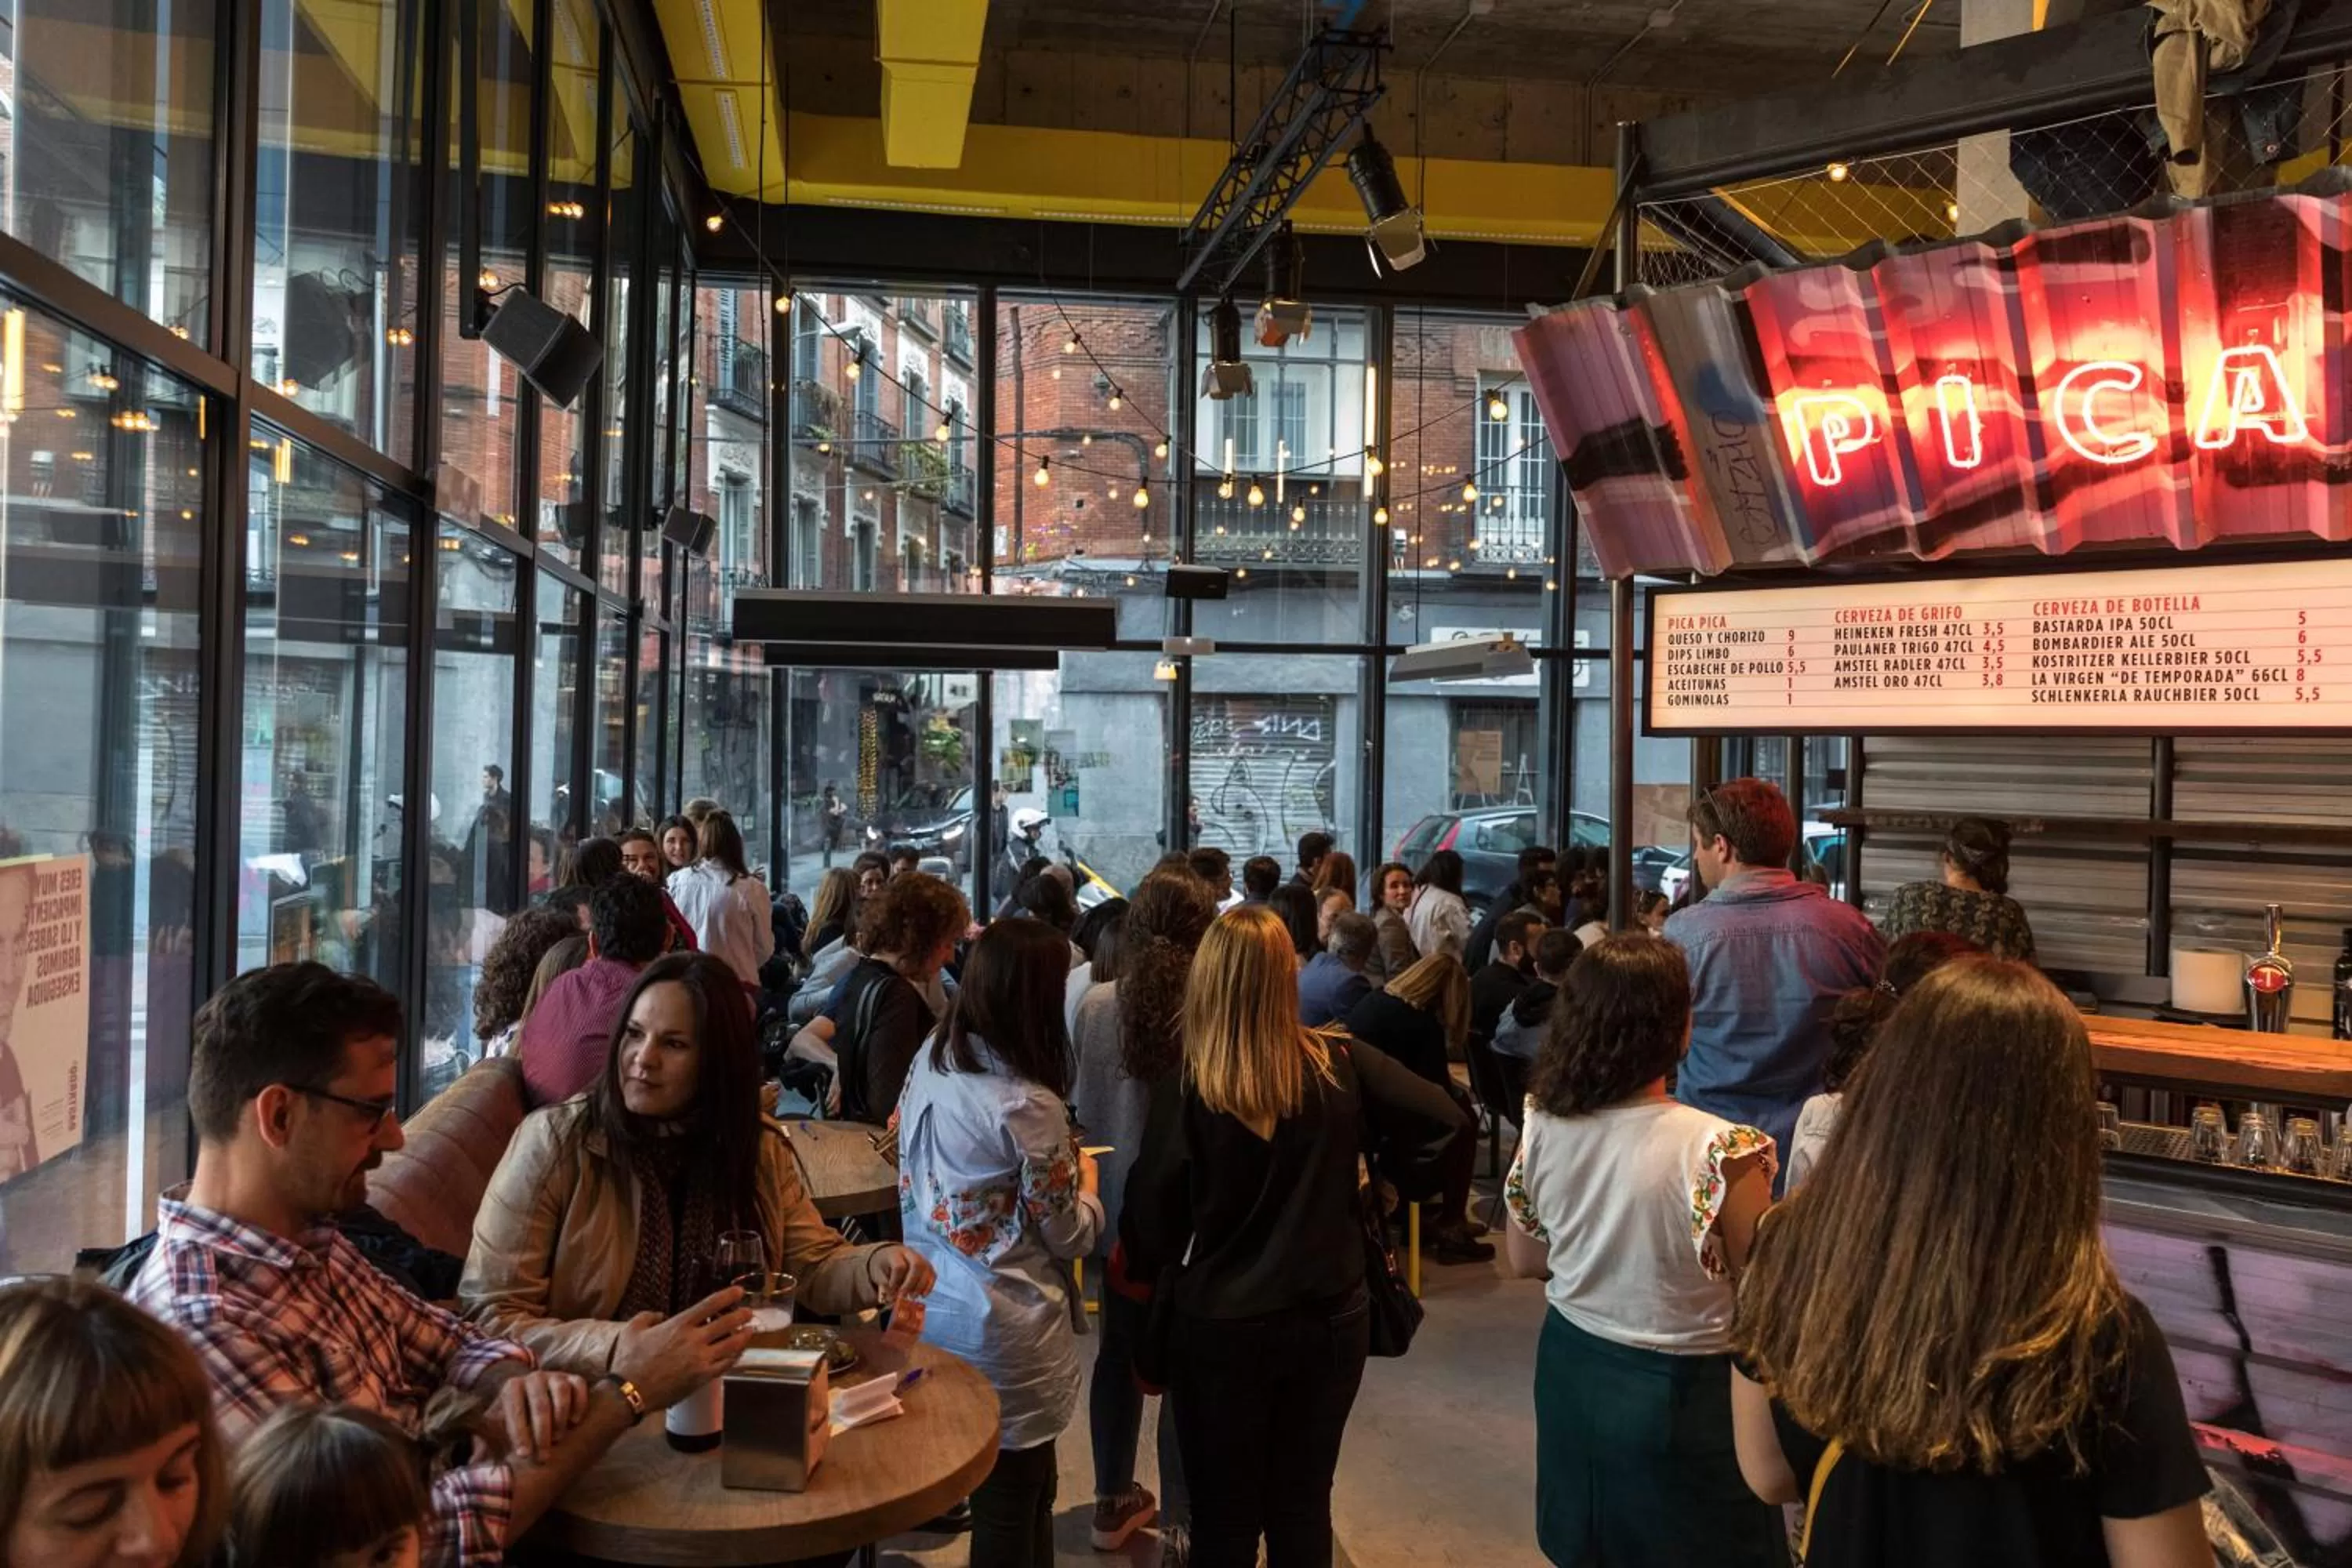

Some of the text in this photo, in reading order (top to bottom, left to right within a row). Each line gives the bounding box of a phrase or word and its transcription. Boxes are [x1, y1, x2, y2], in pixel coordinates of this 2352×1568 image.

[1792, 344, 2309, 487] PICA
[2033, 596, 2201, 615] CERVEZA DE BOTELLA
[1668, 615, 1726, 630] PICA PICA
[1835, 606, 1962, 623] CERVEZA DE GRIFO
[2033, 611, 2307, 633] BASTARDA IPA 50CL 5
[1668, 630, 1795, 645] QUESO Y CHORIZO 9
[1834, 622, 2003, 641] HEINEKEN FRESH 47CL 3,5
[1834, 640, 2004, 656] PAULANER TRIGO 47CL 4,5
[2032, 630, 2307, 651] BOMBARDIER ALE 50CL 6
[1668, 645, 1795, 661] DIPS LIMBO 6
[2032, 648, 2322, 668] KOSTRITZER KELLERBIER 50CL 5,5
[1668, 661, 1806, 675] ESCABECHE DE POLLO 5,5
[1834, 656, 2003, 672] AMSTEL RADLER 47CL 3,5
[1668, 677, 1793, 691] ACEITUNAS 1
[1834, 673, 2003, 688] AMSTEL ORO 47CL 3,8
[2031, 672, 2047, 686] LA
[2053, 671, 2104, 684] VIRGEN
[2251, 668, 2288, 683] 66CL
[2296, 667, 2305, 682] 8
[1668, 692, 1792, 706] GOMINOLAS 1
[2031, 686, 2321, 703] SCHLENKERLA RAUCHBIER 50CL 5,5
